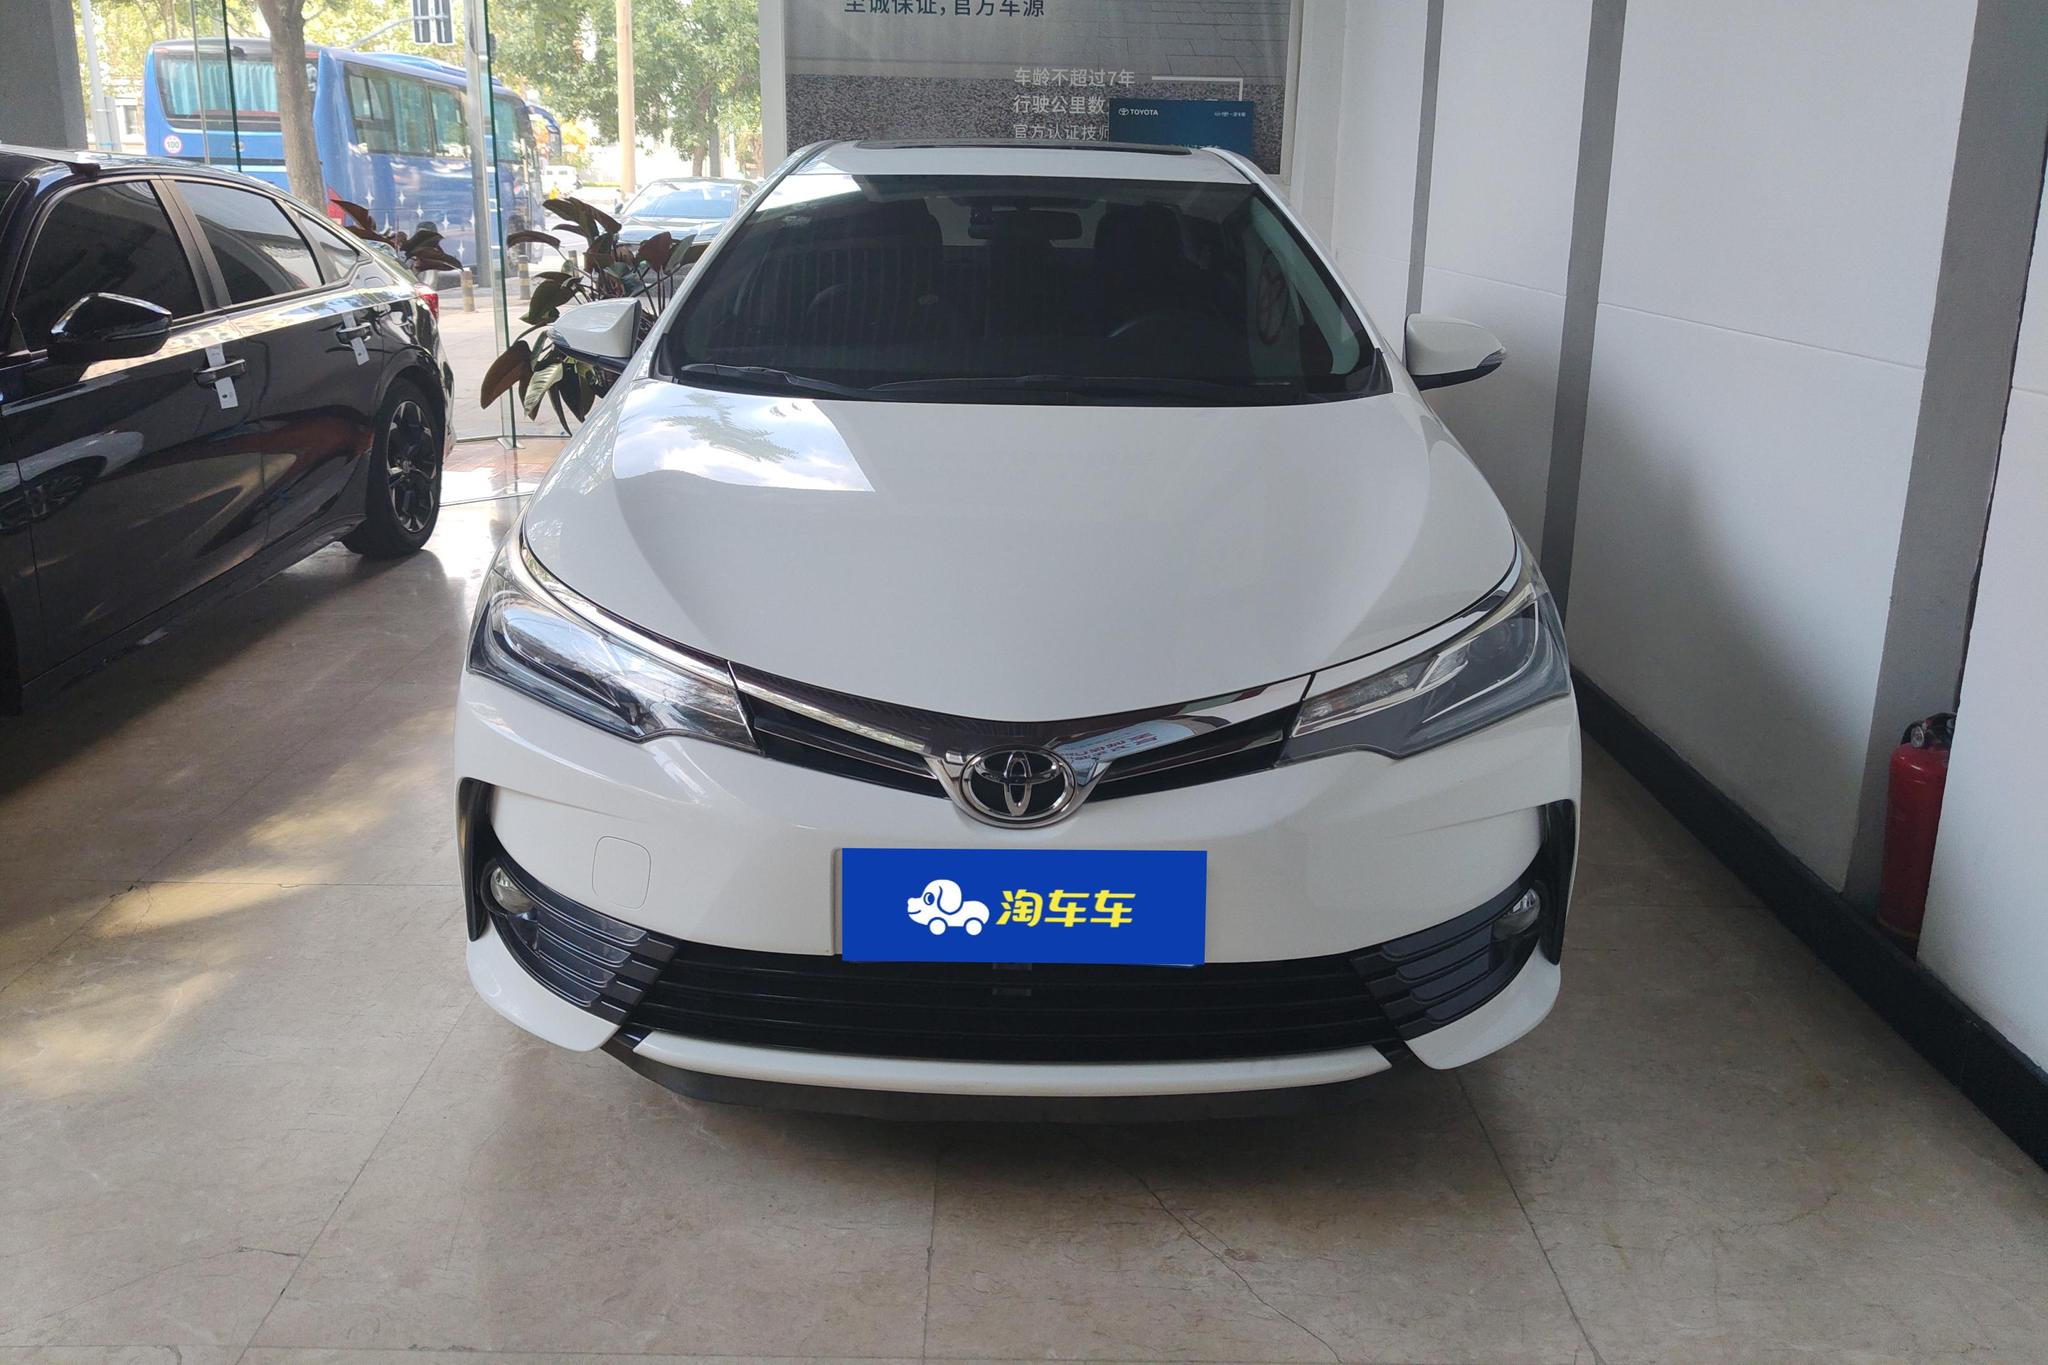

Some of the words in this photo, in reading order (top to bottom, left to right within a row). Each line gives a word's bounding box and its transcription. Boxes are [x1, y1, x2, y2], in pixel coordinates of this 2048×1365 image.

[1014, 67, 1136, 88] 车龄不超过7年
